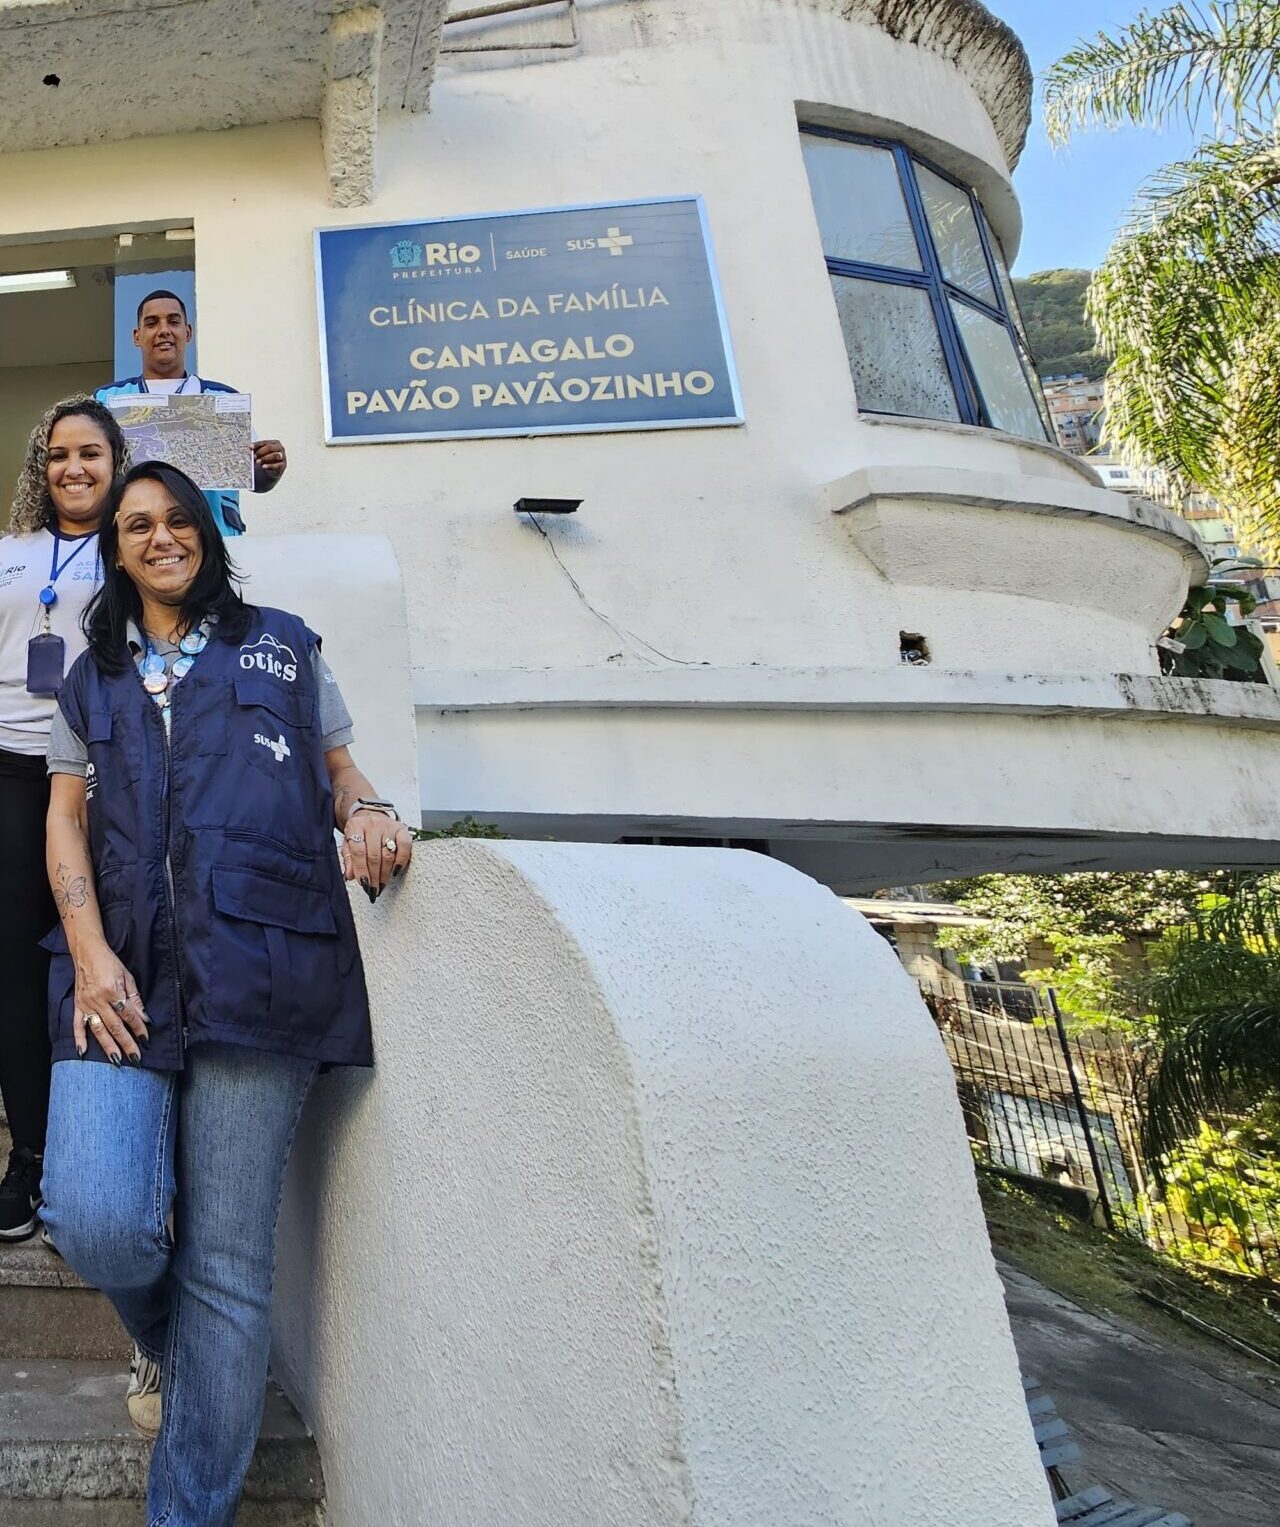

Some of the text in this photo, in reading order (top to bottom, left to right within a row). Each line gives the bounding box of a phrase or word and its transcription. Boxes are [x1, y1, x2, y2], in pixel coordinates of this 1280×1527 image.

[425, 241, 482, 267] Rio
[505, 246, 548, 260] SAÚDE
[566, 238, 596, 251] SUS
[392, 266, 482, 280] PREFEITURA
[369, 283, 670, 327] CLÍNICA DA FAMÍLIA
[409, 333, 635, 371] CANTAGALO
[347, 370, 715, 415] PAVÃO PAVÃOZINHO
[240, 651, 297, 682] otics
[254, 733, 272, 748] SUS
